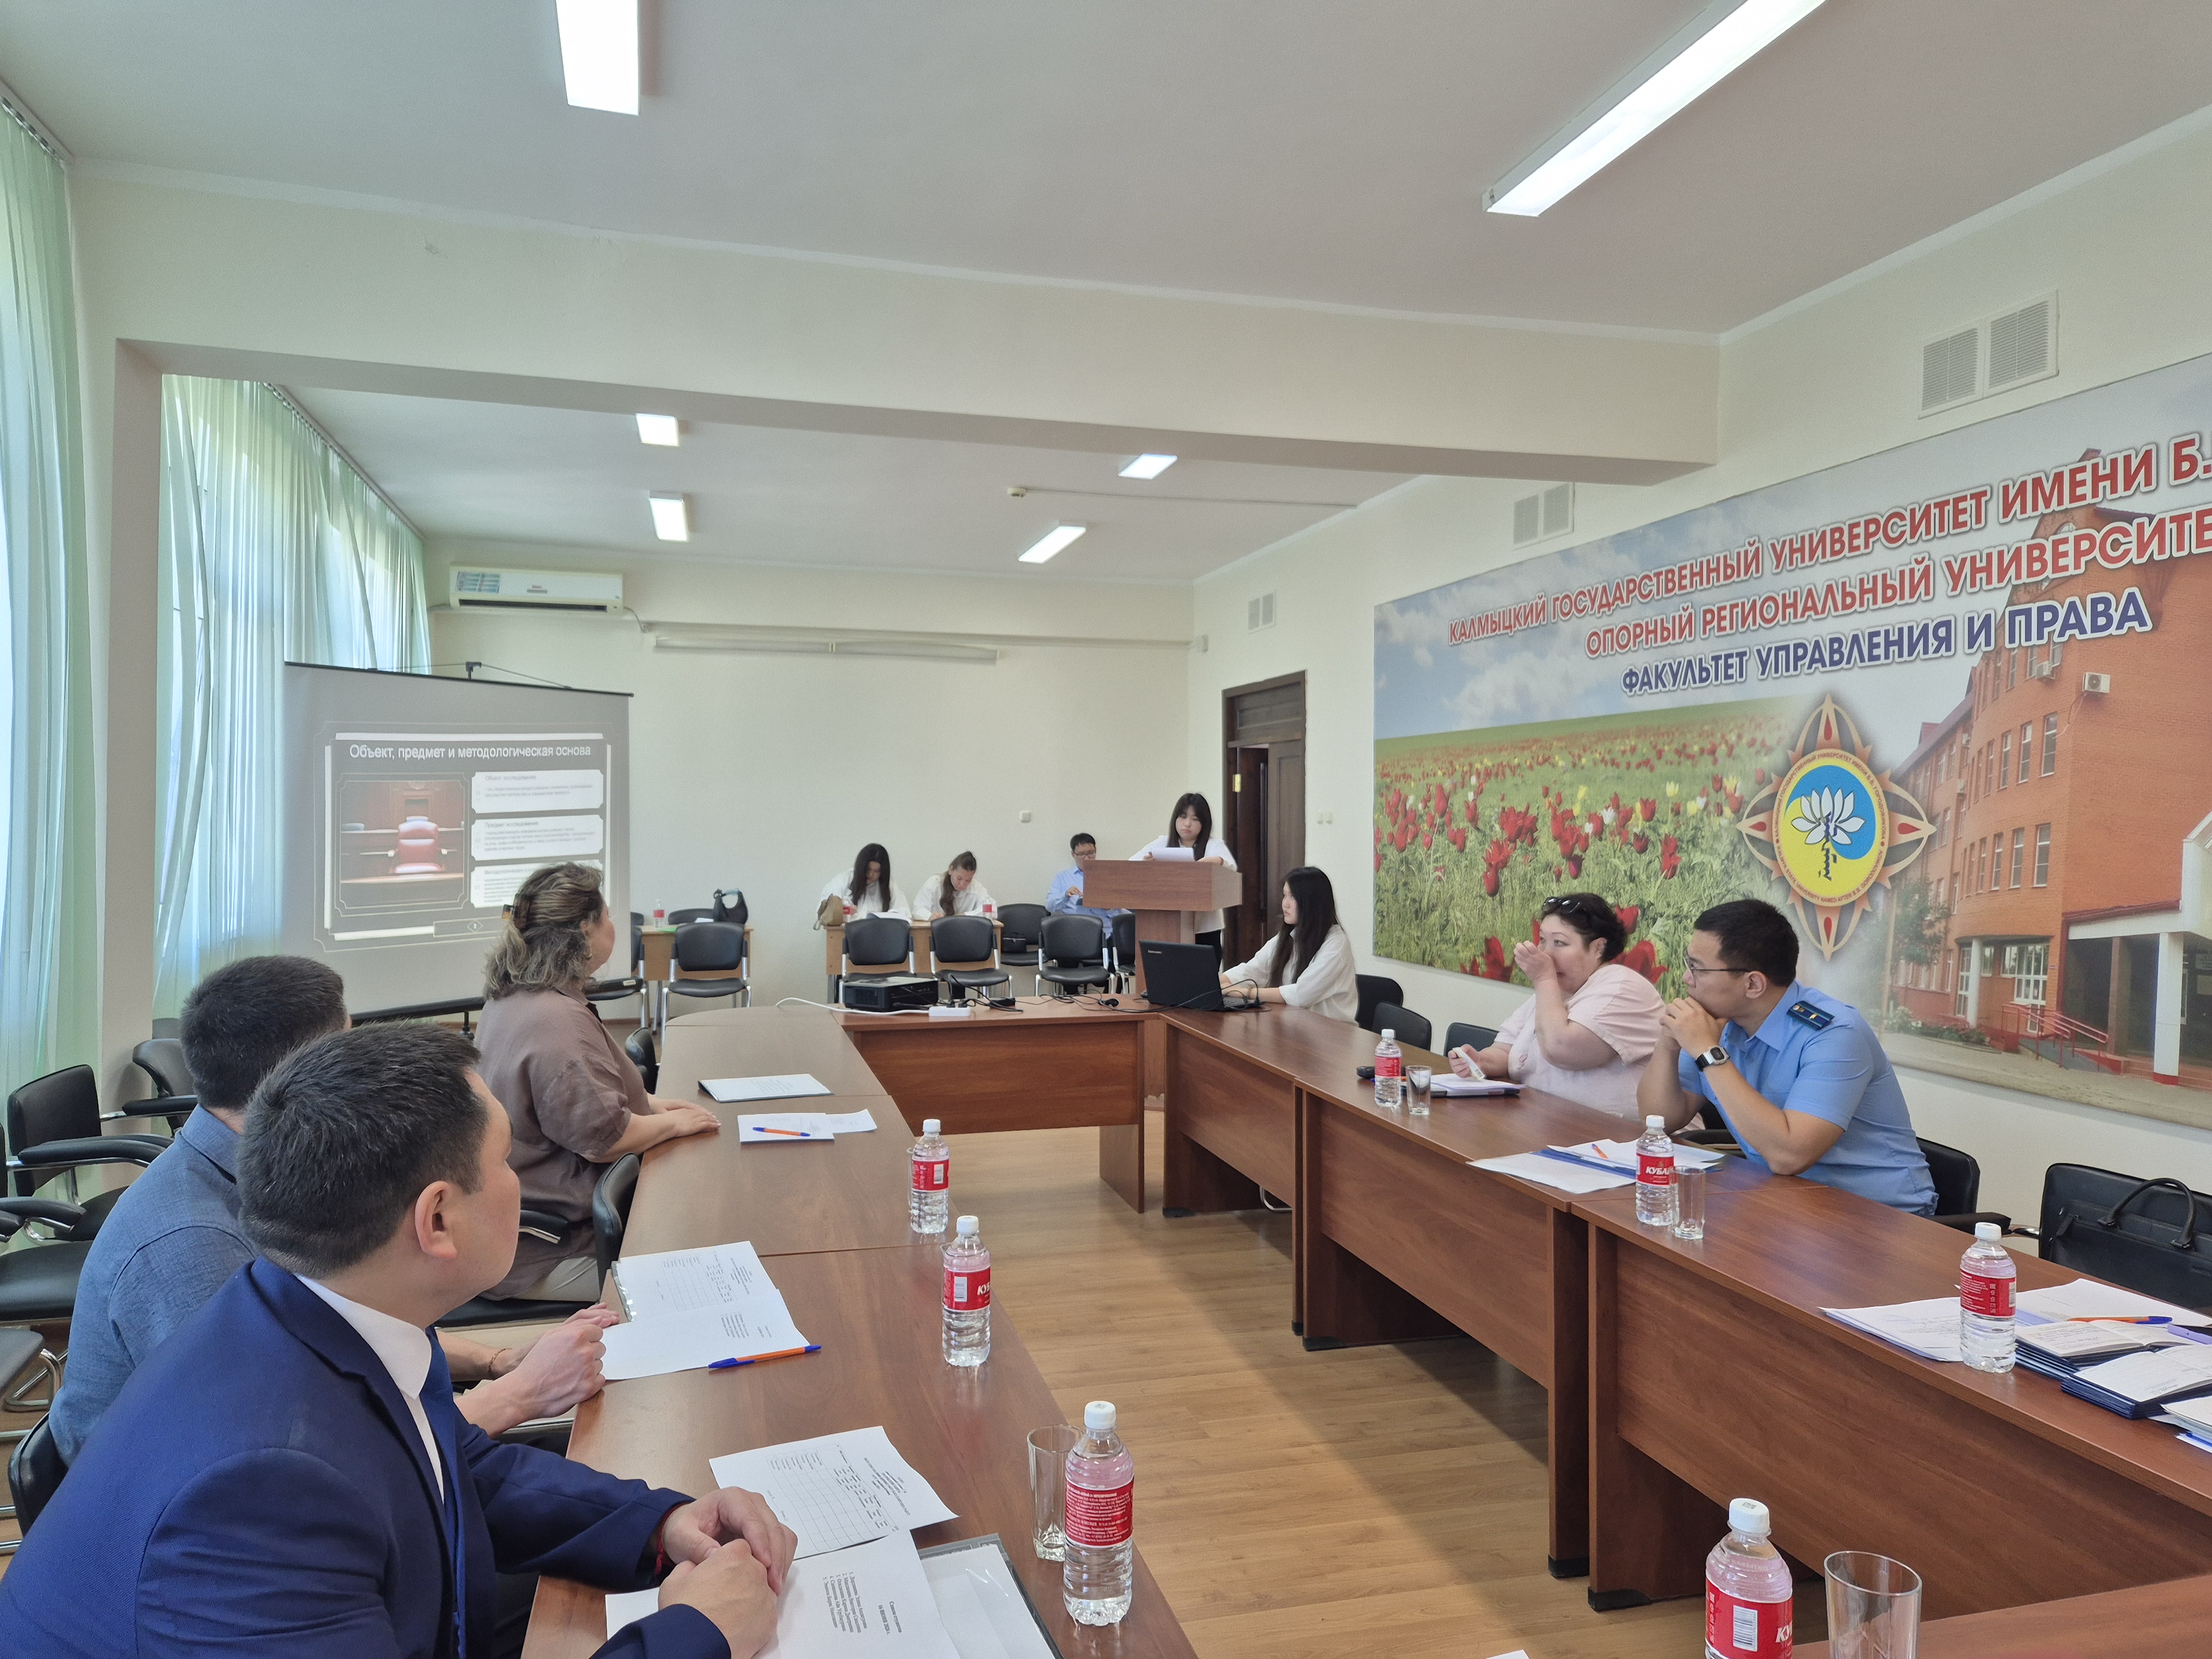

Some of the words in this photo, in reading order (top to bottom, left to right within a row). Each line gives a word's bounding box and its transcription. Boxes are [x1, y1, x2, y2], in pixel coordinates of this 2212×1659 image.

[1449, 595, 1547, 644] КАЛМЫЦКИЙ
[1552, 540, 1760, 620] ГОСУДАРСТВЕННЫЙ
[1770, 490, 1987, 570] УНИВЕРСИТЕТ
[2002, 448, 2153, 519] ИМЕНИ
[2173, 438, 2211, 482] Б.
[1586, 607, 1693, 655] ОПОРНЫЙ
[1702, 556, 1931, 635] РЕГИОНАЛЬНЫЙ
[1944, 508, 2212, 592] УНИВЕРСИТЕ
[1623, 651, 1748, 693] ФАКУЛЬТЕТ
[1756, 619, 1953, 677] УПРАВЛЕНИЯ
[1967, 613, 1992, 650] И
[2008, 591, 2148, 645] ПРАВА
[349, 744, 395, 760] Объект,
[398, 747, 446, 761] предмет
[448, 748, 455, 758] и
[458, 747, 554, 759] методологическая
[555, 745, 591, 757] основа
